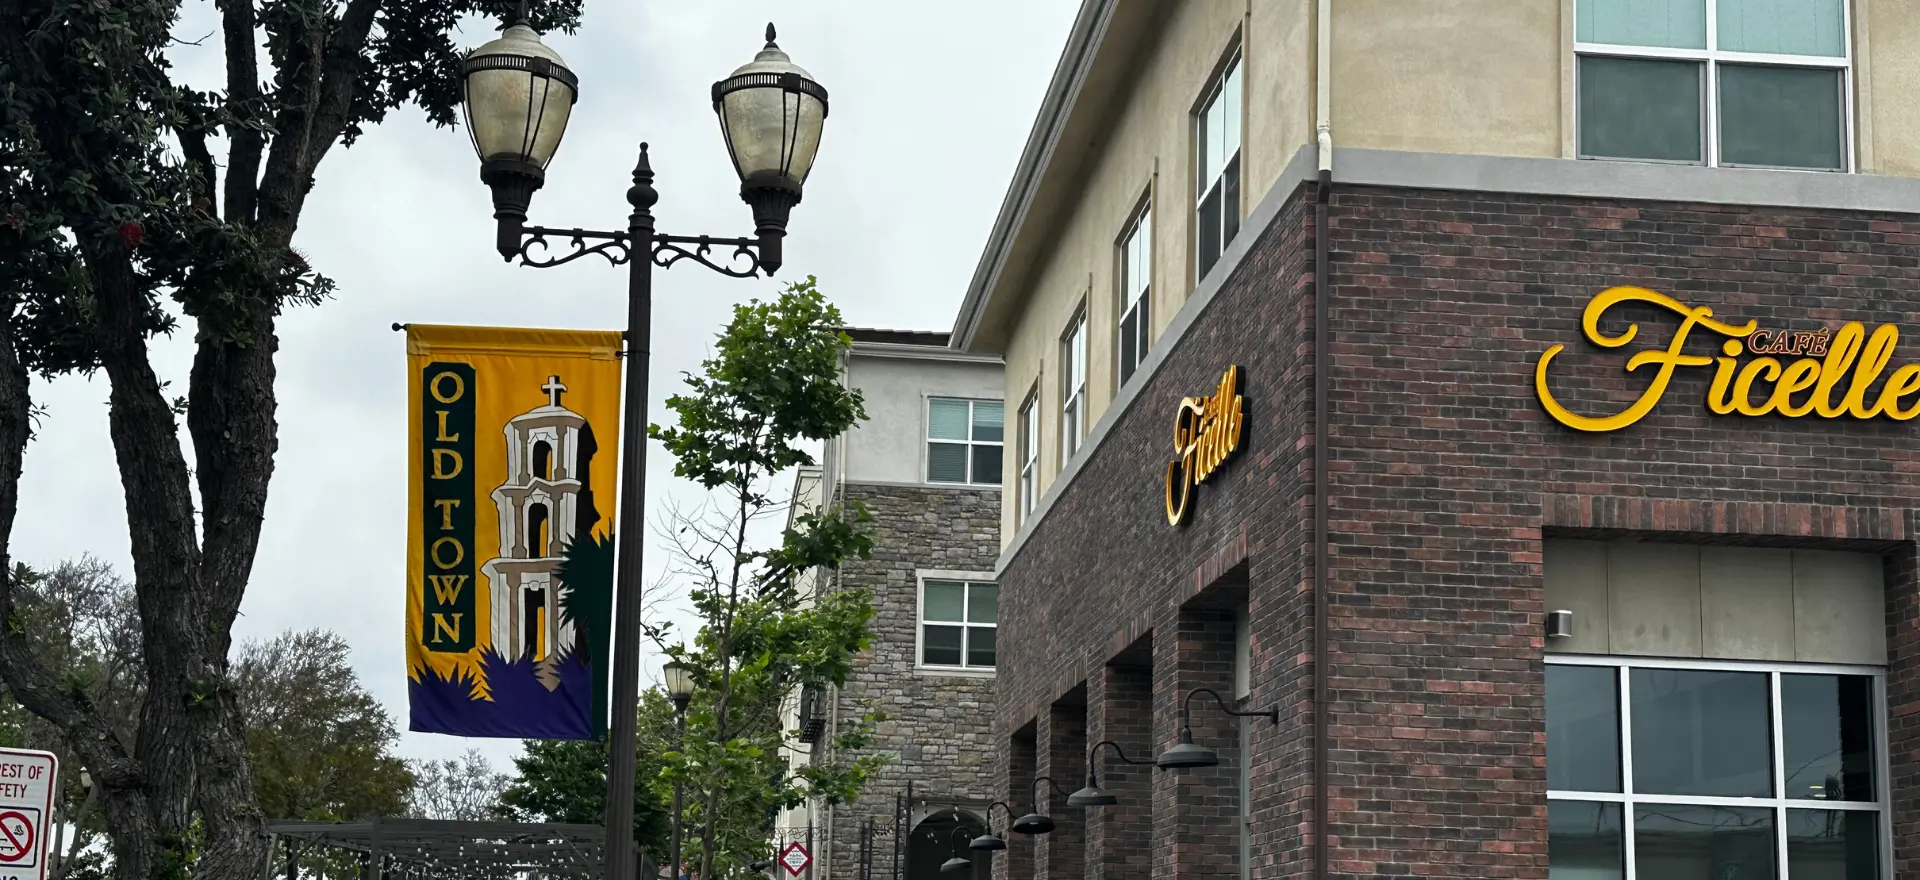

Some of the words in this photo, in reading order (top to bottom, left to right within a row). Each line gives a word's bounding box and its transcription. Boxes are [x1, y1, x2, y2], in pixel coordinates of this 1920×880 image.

[1535, 285, 1920, 432] Ficelle
[1748, 327, 1830, 356] CAFÉ
[430, 371, 464, 480] OLD
[1166, 364, 1244, 526] Ficelle
[428, 499, 469, 643] TOWN
[0, 763, 24, 778] EST
[28, 765, 44, 780] OF
